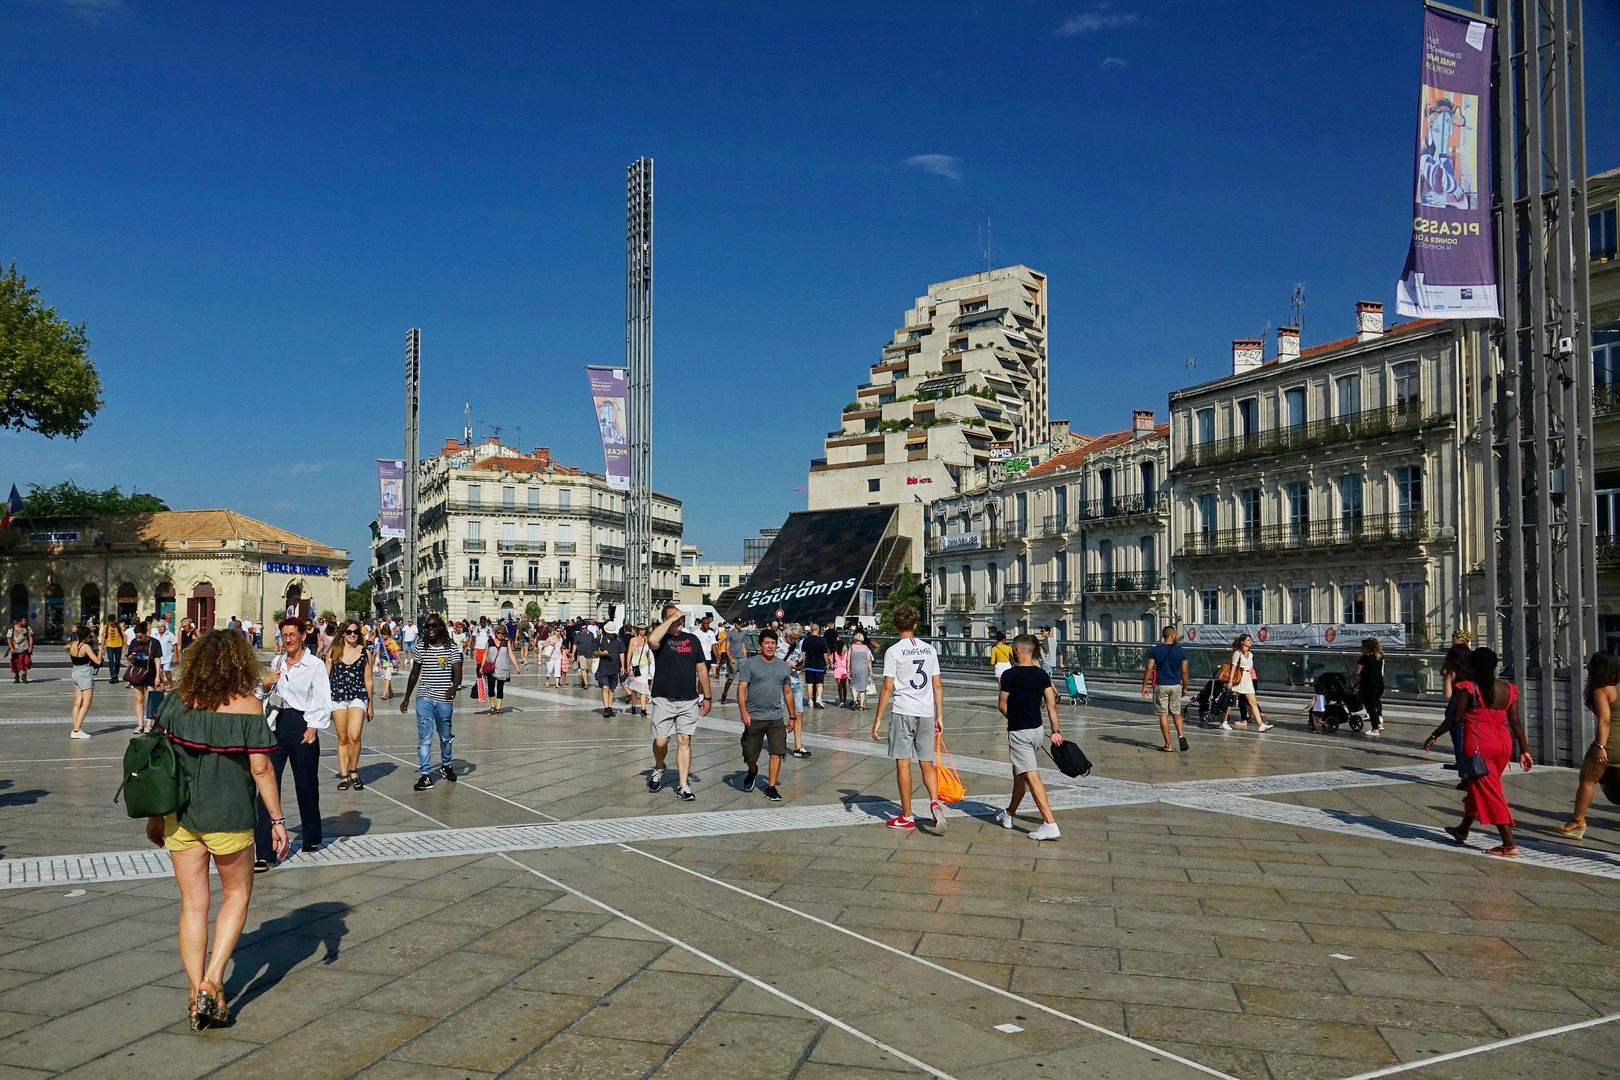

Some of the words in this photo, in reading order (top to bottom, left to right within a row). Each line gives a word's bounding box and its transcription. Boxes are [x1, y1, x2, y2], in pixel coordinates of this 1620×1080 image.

[266, 561, 288, 573] OFFICE
[299, 564, 329, 577] TOURISME
[738, 580, 815, 600] librairie
[747, 577, 856, 608] sauramps
[902, 647, 932, 656] KIMPEMBE
[909, 659, 928, 690] 3
